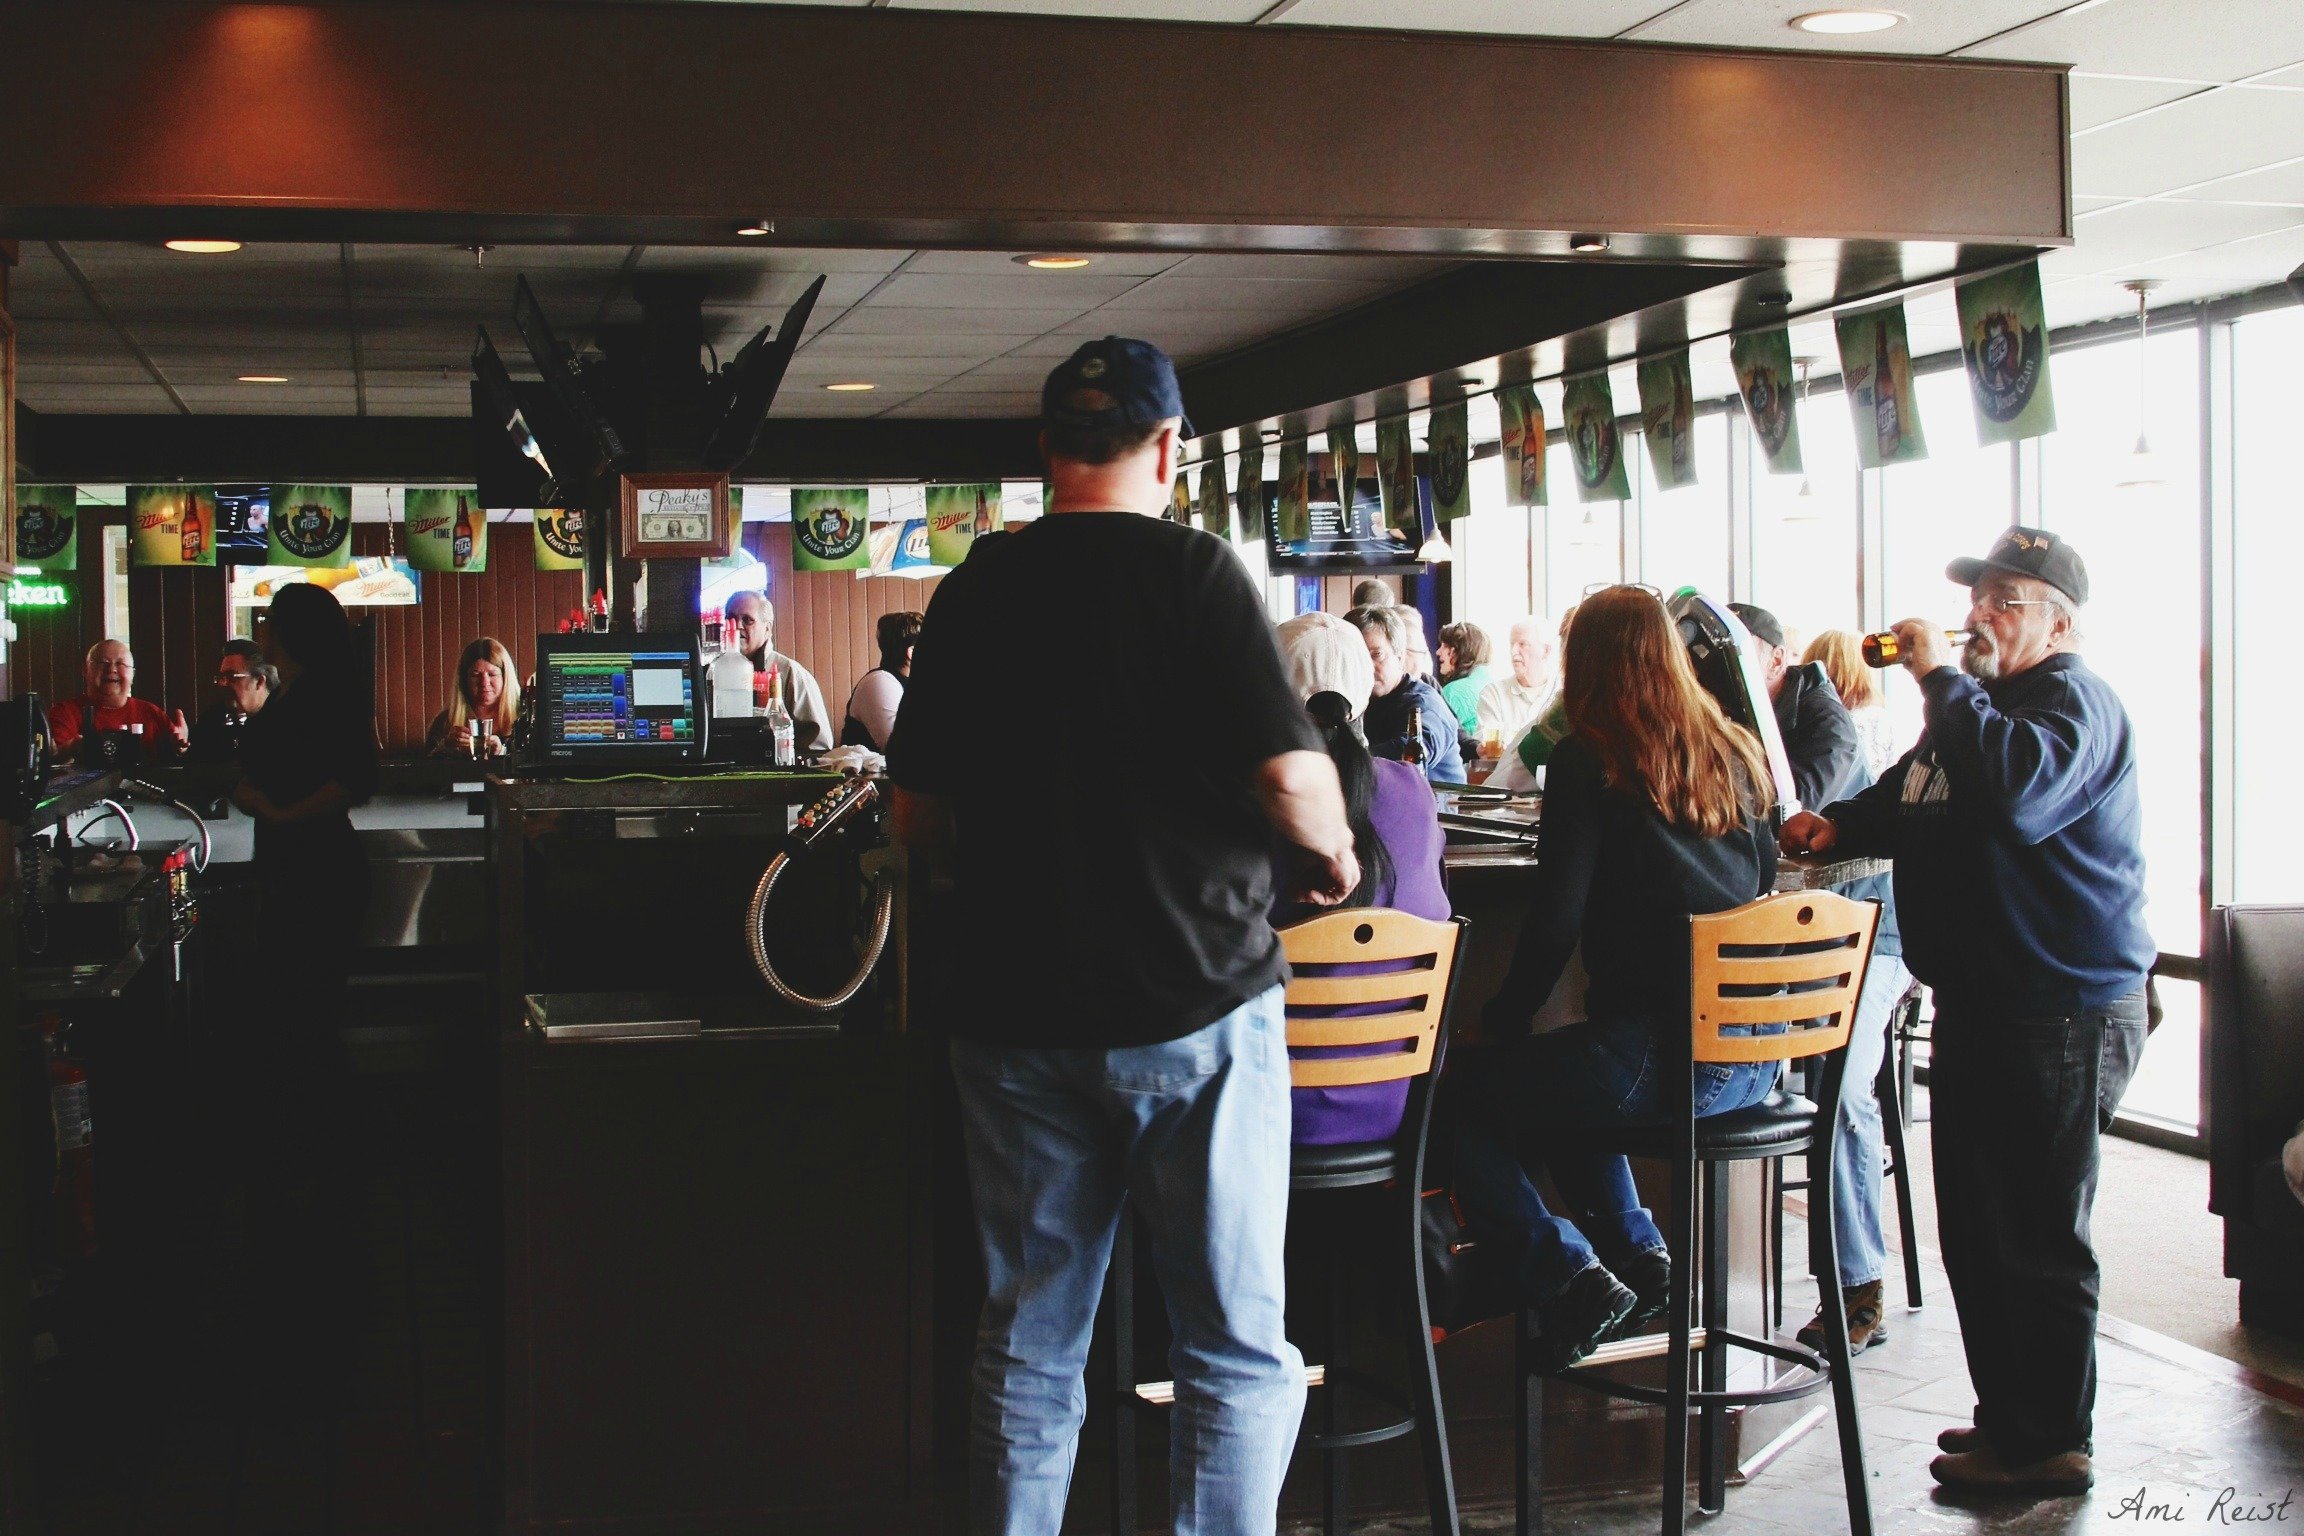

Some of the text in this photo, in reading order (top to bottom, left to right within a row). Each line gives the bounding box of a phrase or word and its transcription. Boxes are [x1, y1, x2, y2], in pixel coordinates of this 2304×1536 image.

[161, 523, 179, 534] TIME
[408, 516, 451, 535] Miller
[930, 511, 972, 532] Miller
[955, 523, 972, 534] TIME
[824, 545, 845, 557] Your
[844, 532, 861, 549] Clan
